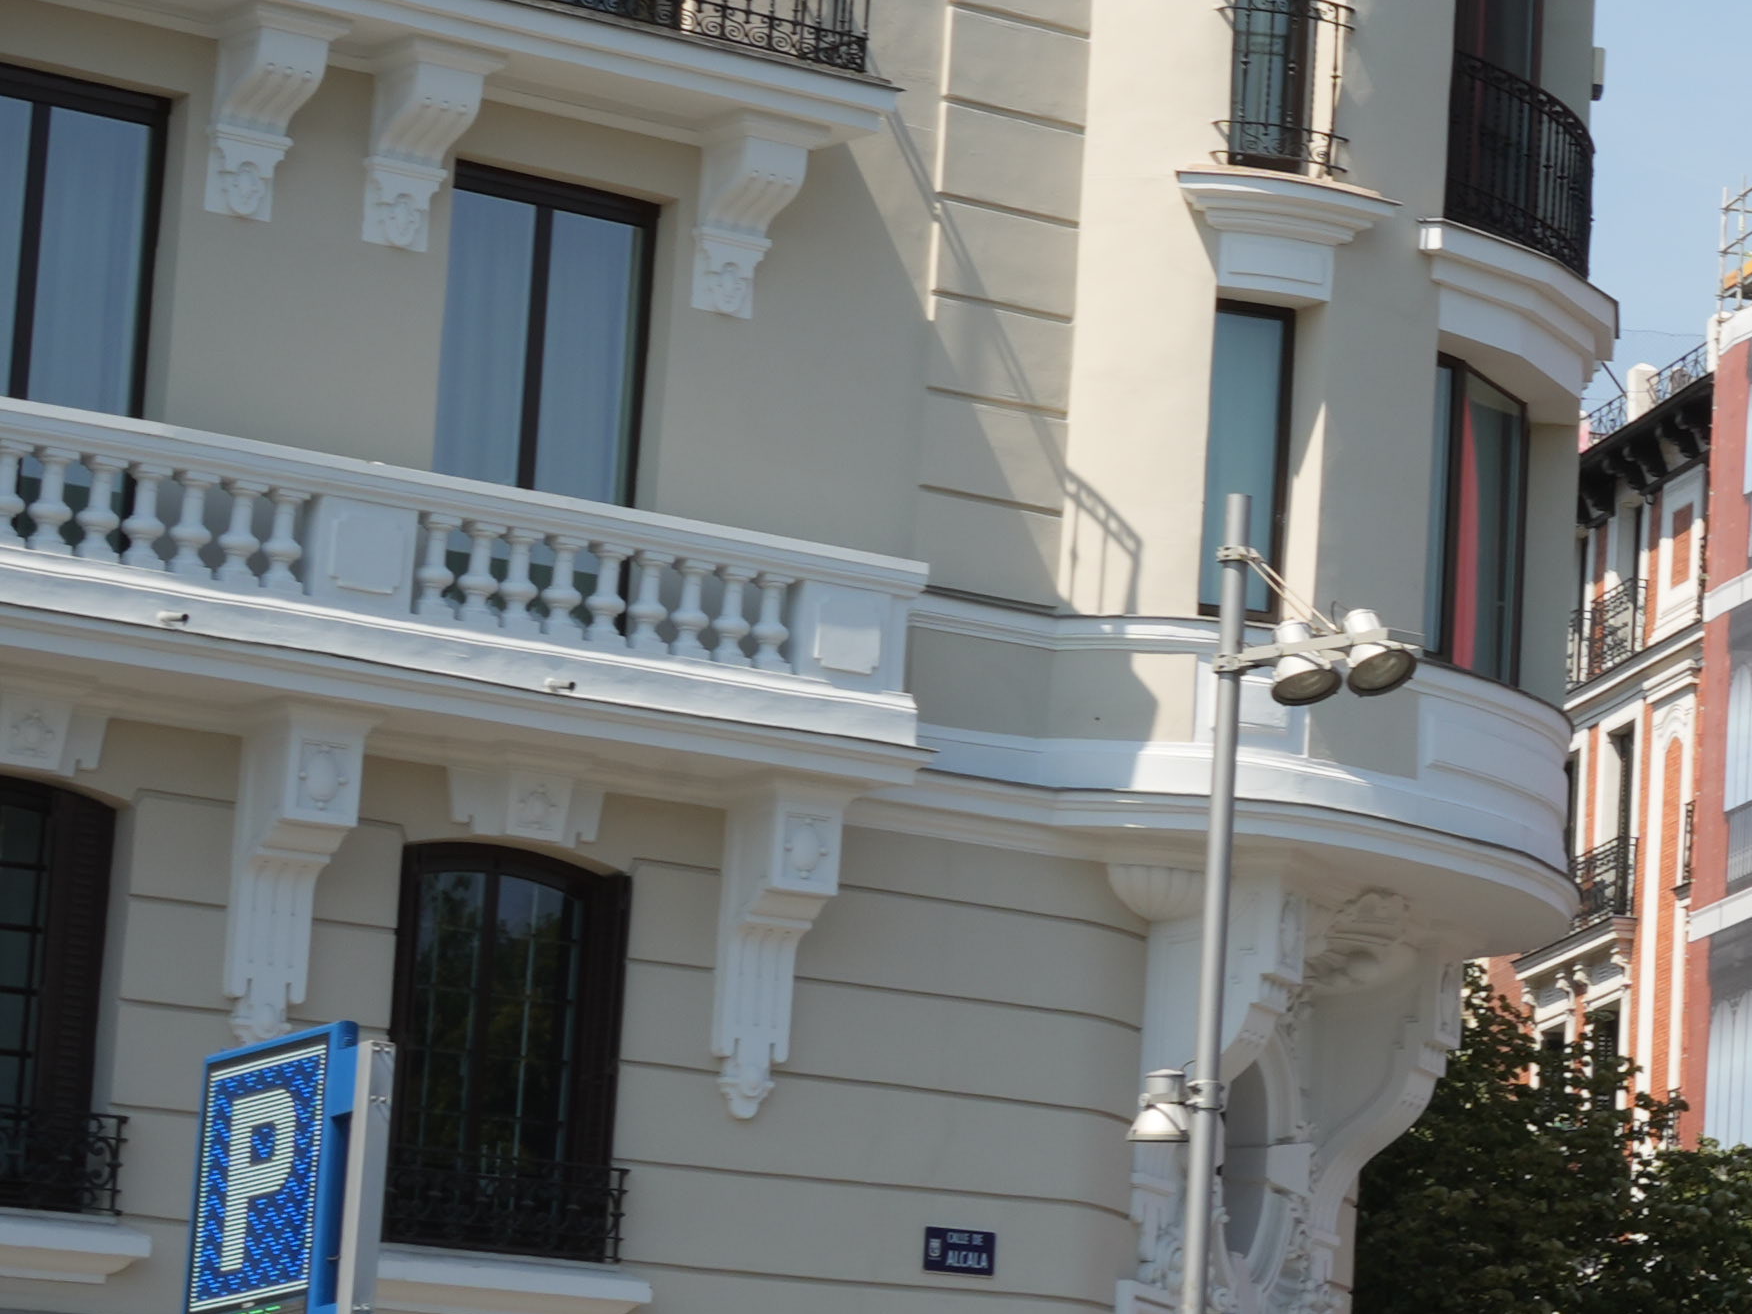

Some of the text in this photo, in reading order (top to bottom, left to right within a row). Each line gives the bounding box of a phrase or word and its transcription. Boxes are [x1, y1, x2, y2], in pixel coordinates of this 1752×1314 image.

[220, 1088, 296, 1273] P
[946, 1231, 985, 1245] CALLE DE
